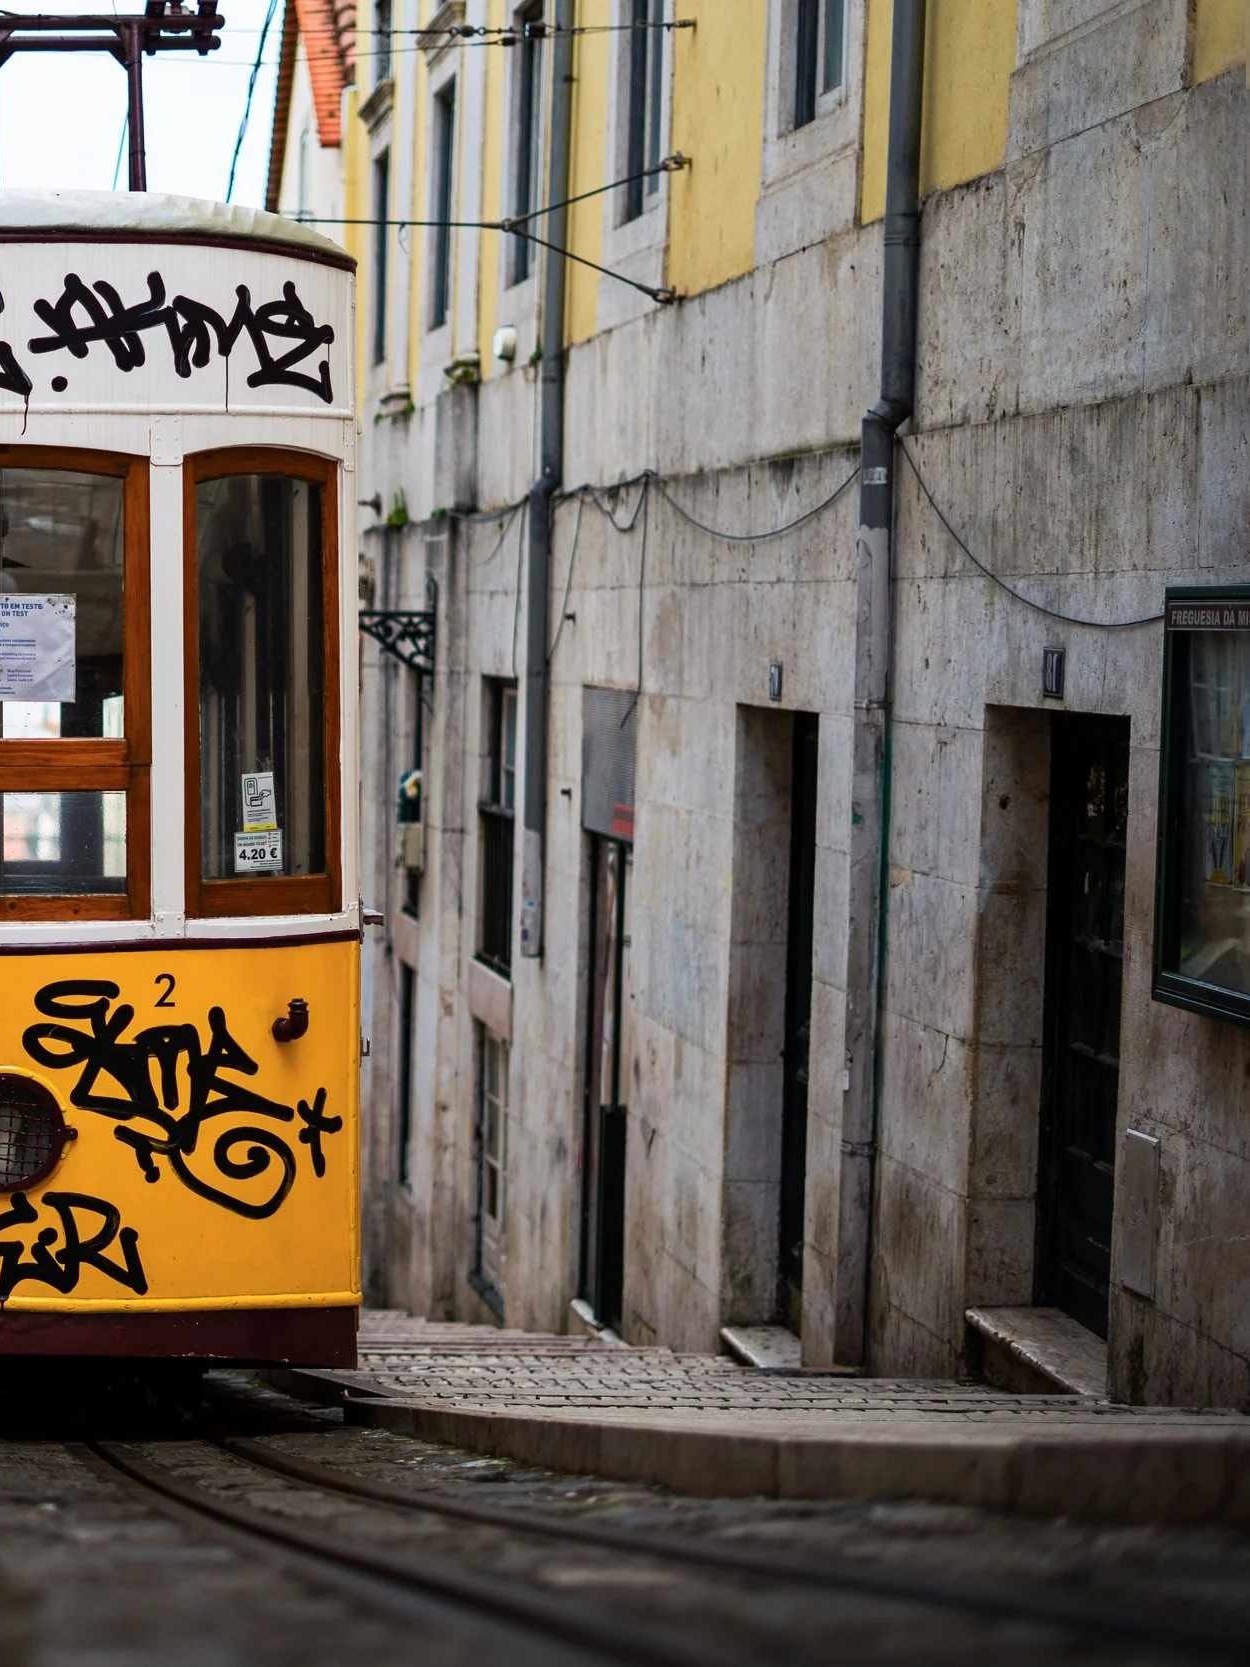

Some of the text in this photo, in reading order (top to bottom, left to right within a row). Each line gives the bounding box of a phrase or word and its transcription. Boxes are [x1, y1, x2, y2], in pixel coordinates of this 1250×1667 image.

[1172, 610, 1250, 626] FREGUESIA DA MI
[239, 848, 266, 860] 4.20
[154, 973, 176, 1007] 2
